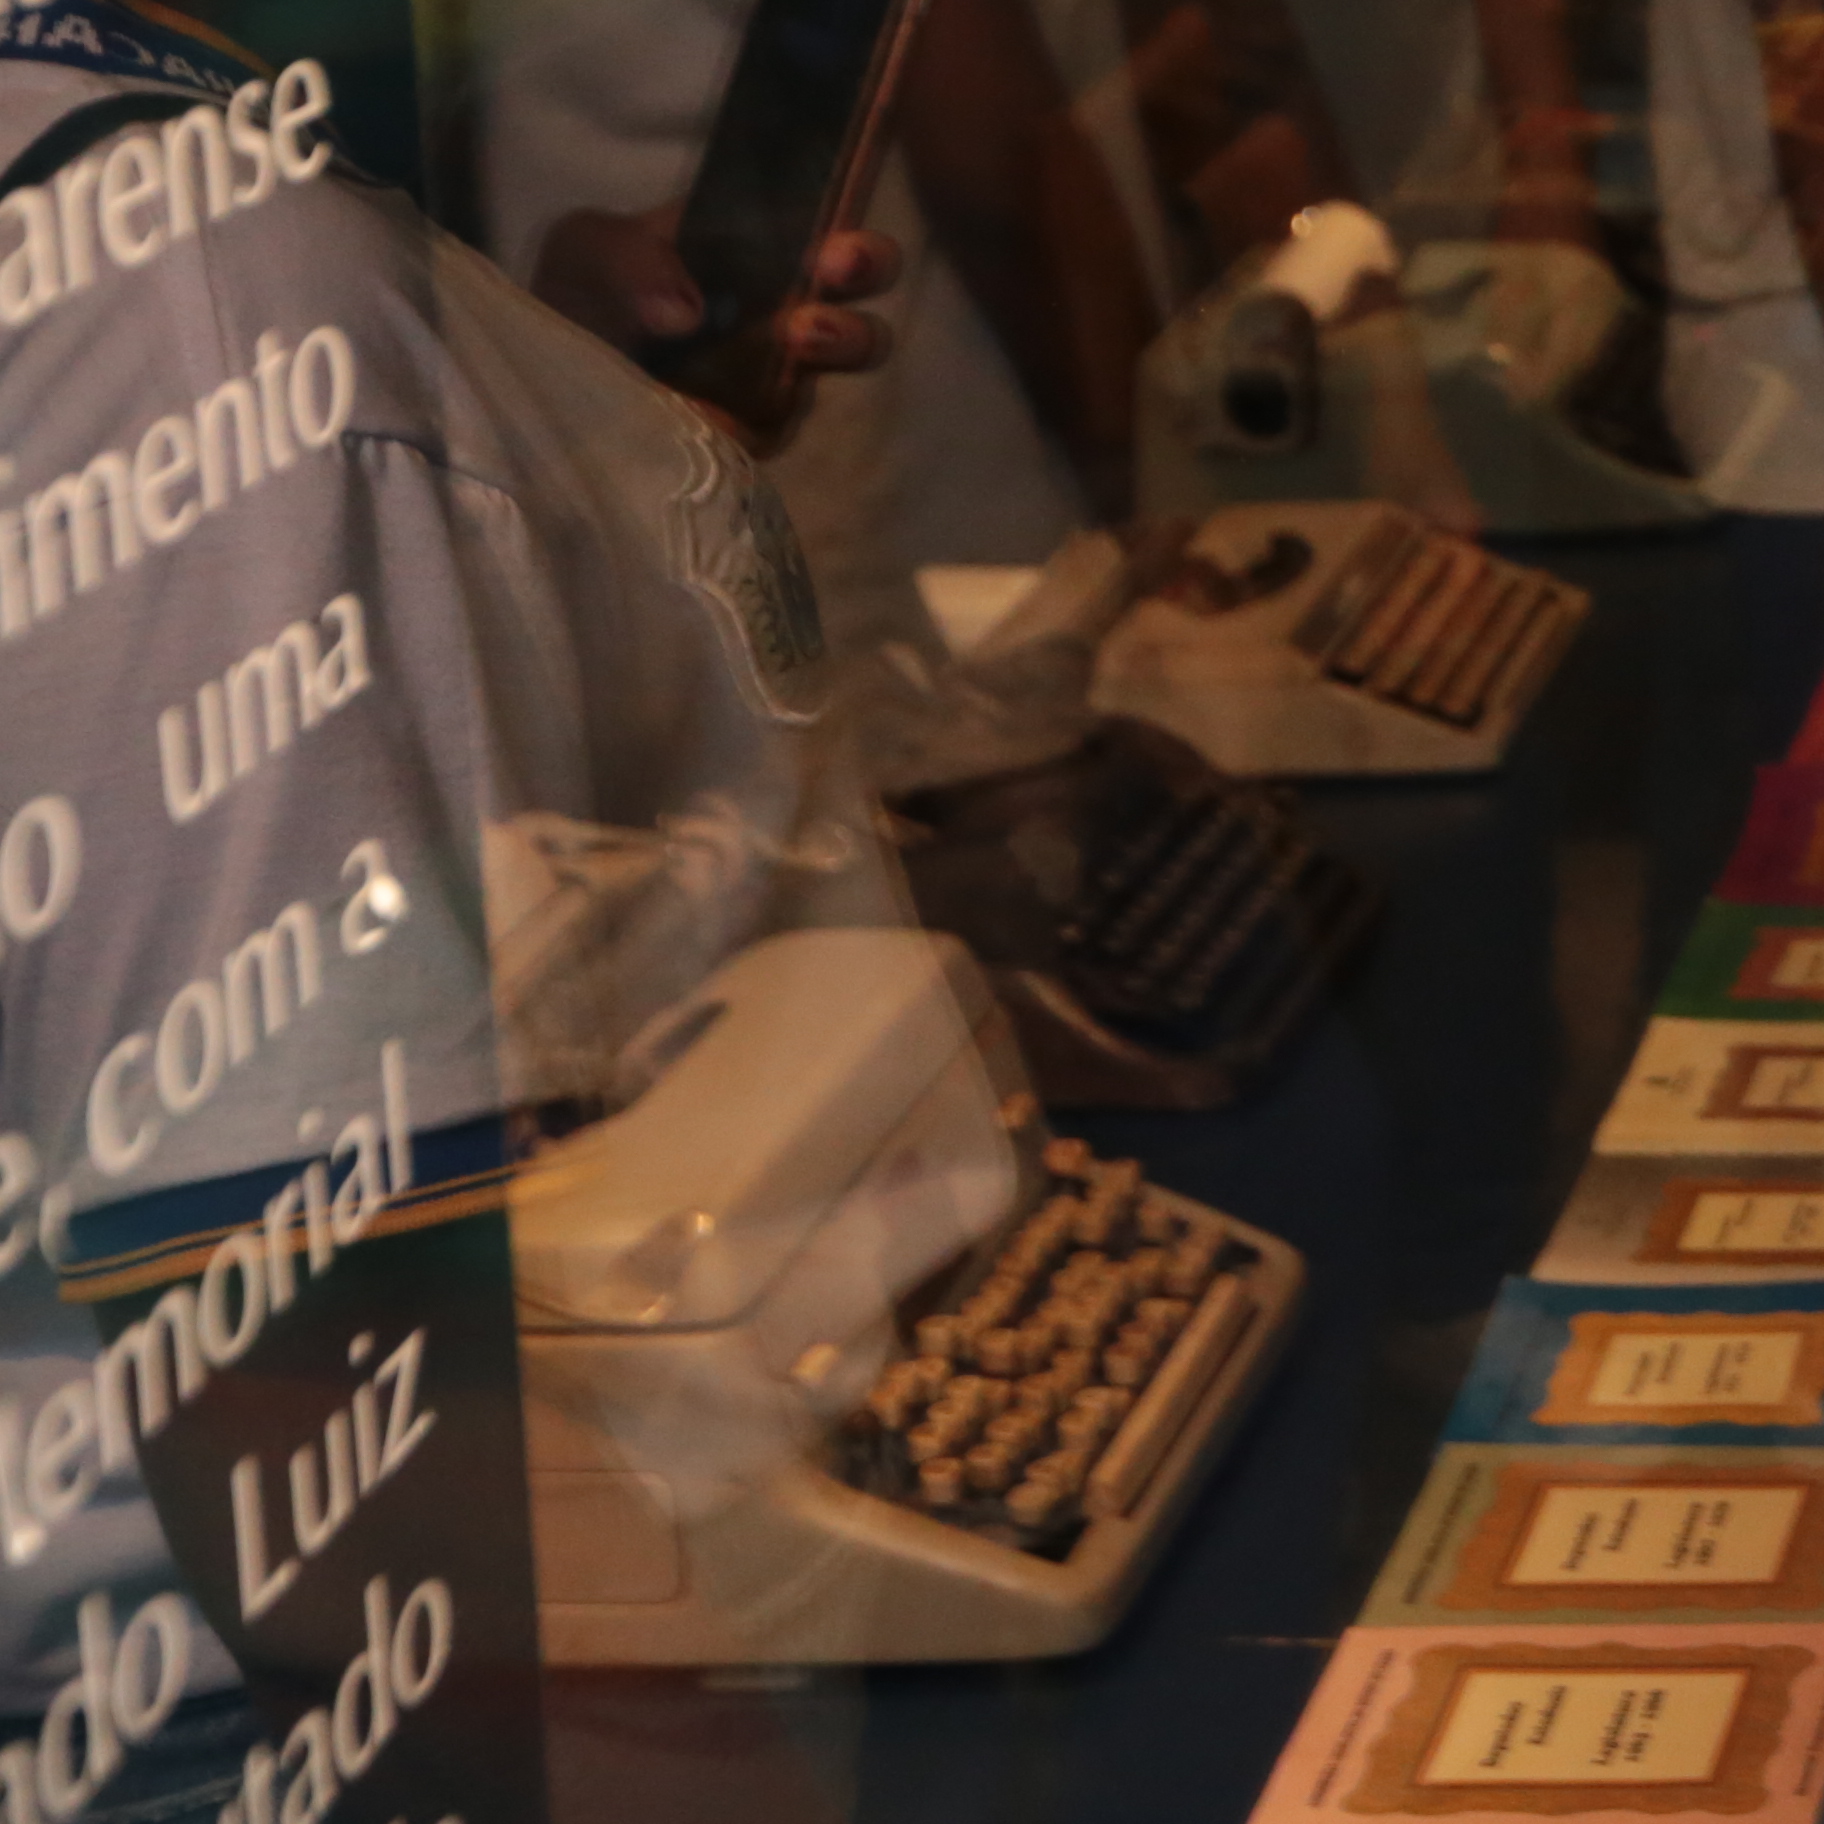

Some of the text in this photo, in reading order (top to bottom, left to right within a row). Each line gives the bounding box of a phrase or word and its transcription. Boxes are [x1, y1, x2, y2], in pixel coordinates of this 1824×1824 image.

[0, 57, 333, 329] arense
[0, 325, 357, 639] imento
[0, 591, 372, 944] o uma
[86, 898, 323, 1173] com
[340, 837, 408, 956] a
[231, 1325, 437, 1624] Luiz
[217, 1574, 454, 1824] tado
